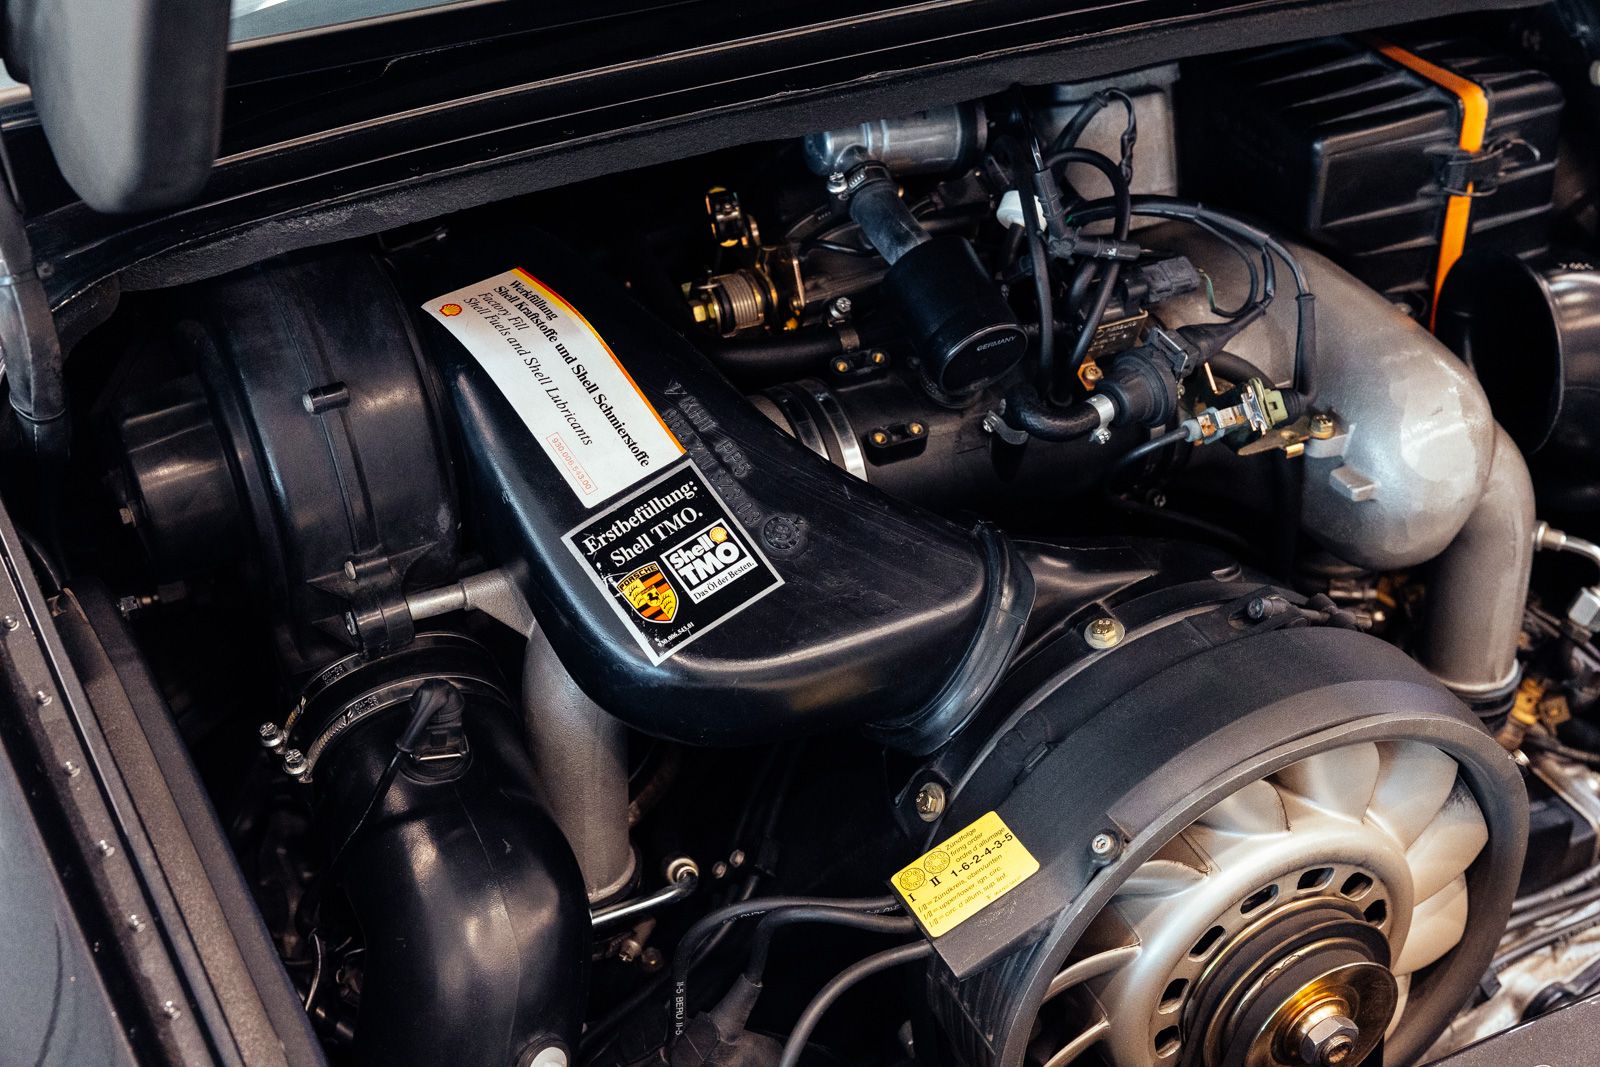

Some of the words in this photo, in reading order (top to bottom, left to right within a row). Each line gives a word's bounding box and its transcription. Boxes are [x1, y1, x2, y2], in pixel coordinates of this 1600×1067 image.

[478, 292, 511, 316] Factory
[508, 316, 530, 331] Fill
[509, 279, 558, 321] Werkfüllung
[976, 335, 1016, 351] GERMANY
[463, 297, 491, 314] Shell
[484, 314, 510, 336] Fuels
[507, 337, 531, 356] and
[524, 357, 552, 385] Shell
[545, 387, 592, 446] Lubricants
[493, 285, 520, 303] Shell
[514, 300, 558, 342] Kraftstoffe
[555, 343, 577, 365] und
[571, 364, 599, 394] Shell
[593, 393, 650, 467] Schmierstoffe
[582, 481, 698, 555] Erstbefüllung:
[610, 533, 654, 567] Shell
[650, 507, 703, 541] TMO.
[669, 533, 715, 569] Shell
[678, 541, 739, 586] TMO
[619, 565, 658, 590] PORSCHE
[693, 590, 709, 601] Das
[706, 581, 718, 592] Öl
[717, 576, 729, 587] der
[727, 561, 754, 579] Besten.
[950, 843, 967, 857] firing
[967, 832, 983, 845] order
[951, 832, 1013, 877] 1-6-2-4-3-5
[955, 850, 972, 863] ordre
[929, 875, 941, 887] II
[675, 996, 684, 1020] BERU
